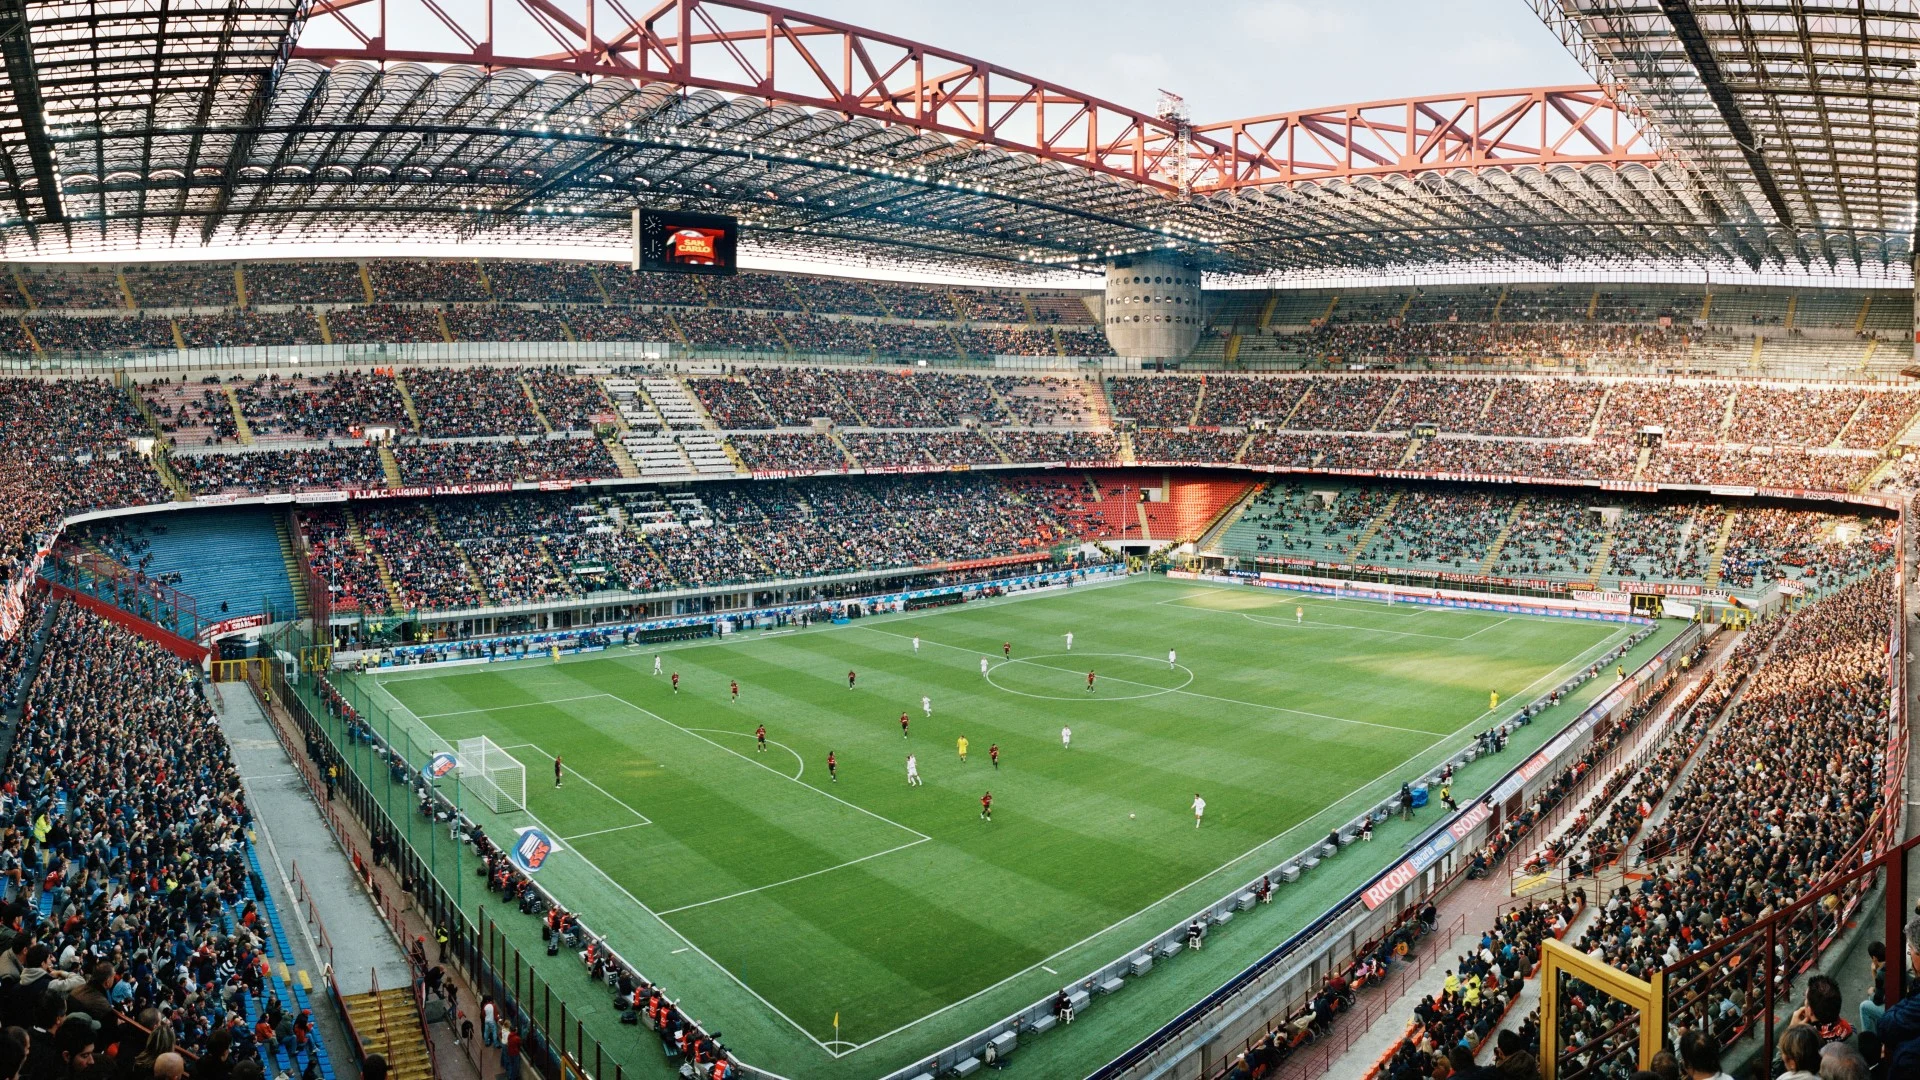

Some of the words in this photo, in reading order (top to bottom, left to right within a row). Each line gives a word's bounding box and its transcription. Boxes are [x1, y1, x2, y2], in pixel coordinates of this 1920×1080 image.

[684, 239, 705, 247] SAN
[678, 245, 711, 253] CARLO
[753, 470, 787, 480] BELLUSCO
[1379, 470, 1426, 480] TORCIDA
[354, 489, 391, 499] A.I.M.C.
[396, 487, 429, 496] LIGURIA
[436, 484, 472, 495] A.I.M.C.
[477, 483, 509, 492] UMBRIA
[1759, 488, 1794, 498] NAVIGLIO
[1803, 491, 1845, 503] ROSSONERO
[1229, 570, 1259, 578] MANIVA
[1666, 584, 1697, 595] PAINA
[1702, 589, 1730, 597] DESIO
[1575, 590, 1601, 601] MARCO
[1610, 593, 1628, 604] NICO
[1453, 805, 1488, 838] SONY
[1410, 844, 1435, 869] Bavaria
[1367, 864, 1413, 907] RICOH
